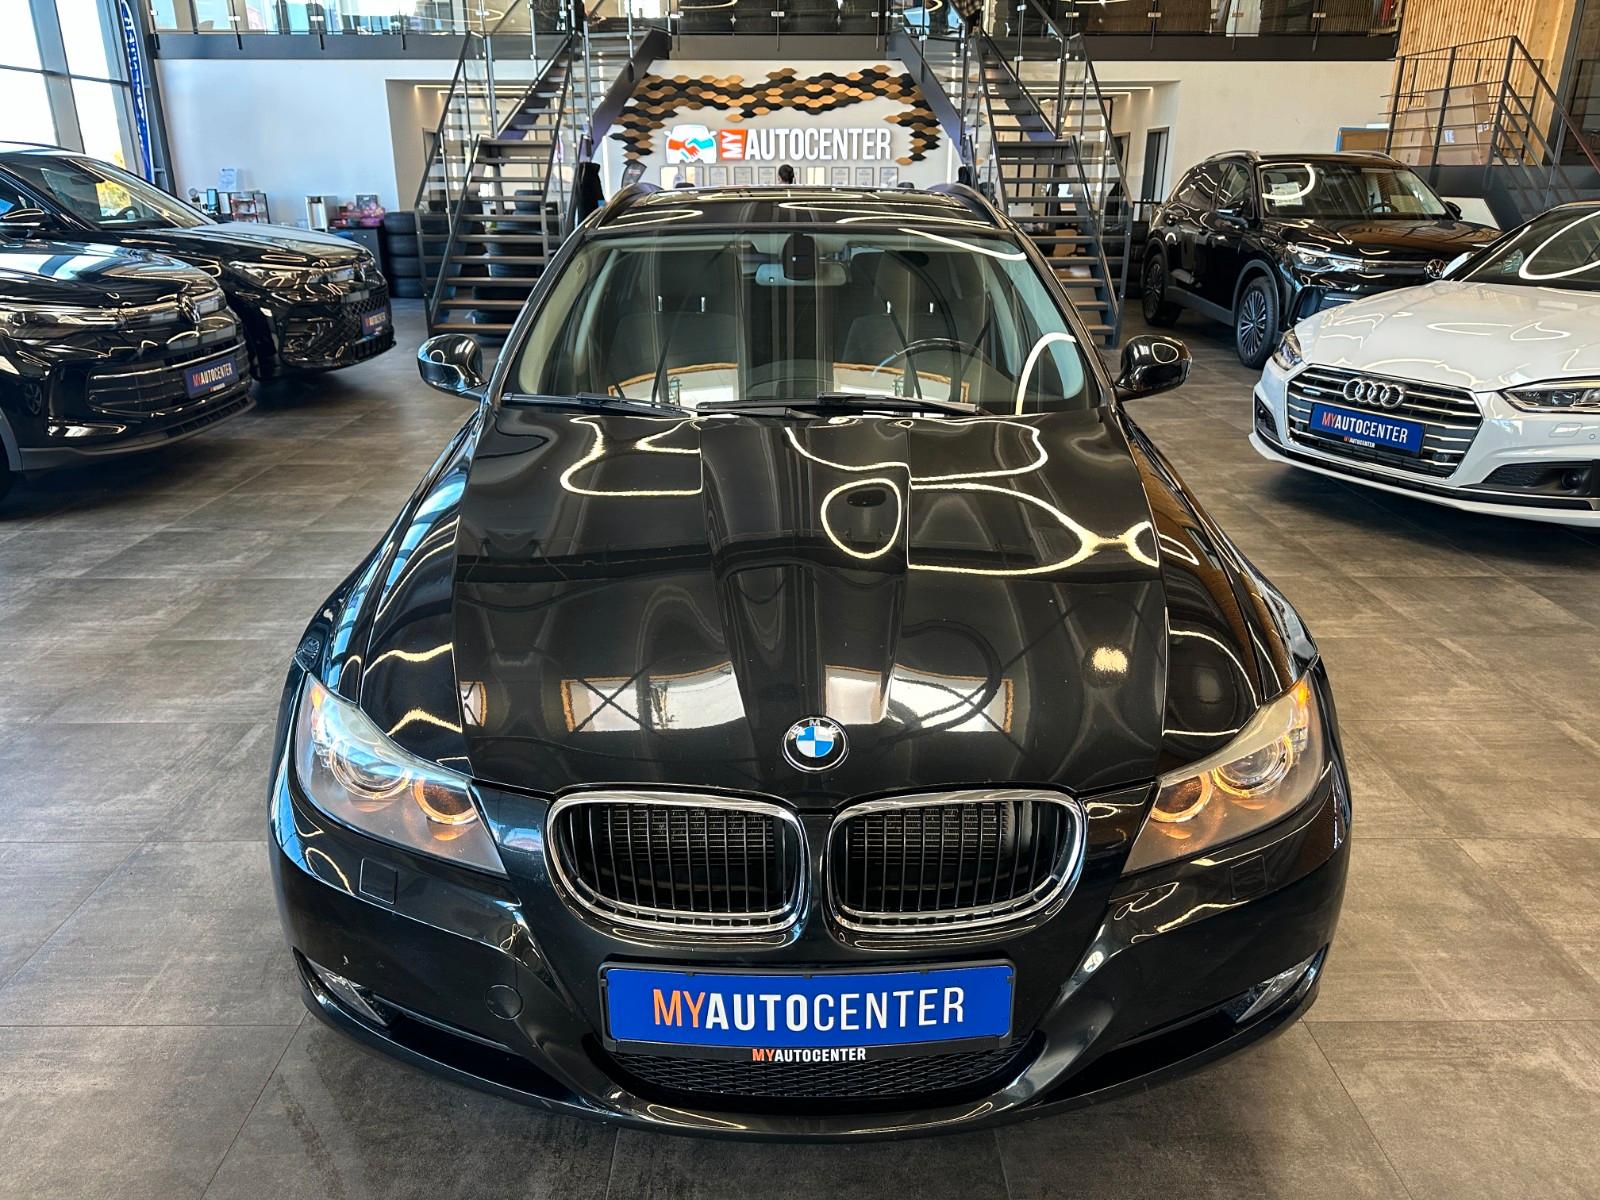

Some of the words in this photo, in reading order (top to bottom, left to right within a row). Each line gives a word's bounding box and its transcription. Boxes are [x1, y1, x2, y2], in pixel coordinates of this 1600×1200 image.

[745, 127, 892, 161] AUTOCENTER
[1321, 411, 1409, 444] MYAUTOCENTER
[652, 986, 965, 1032] MYAUTOCENTER
[751, 1047, 867, 1063] MYAUTOCENTER
